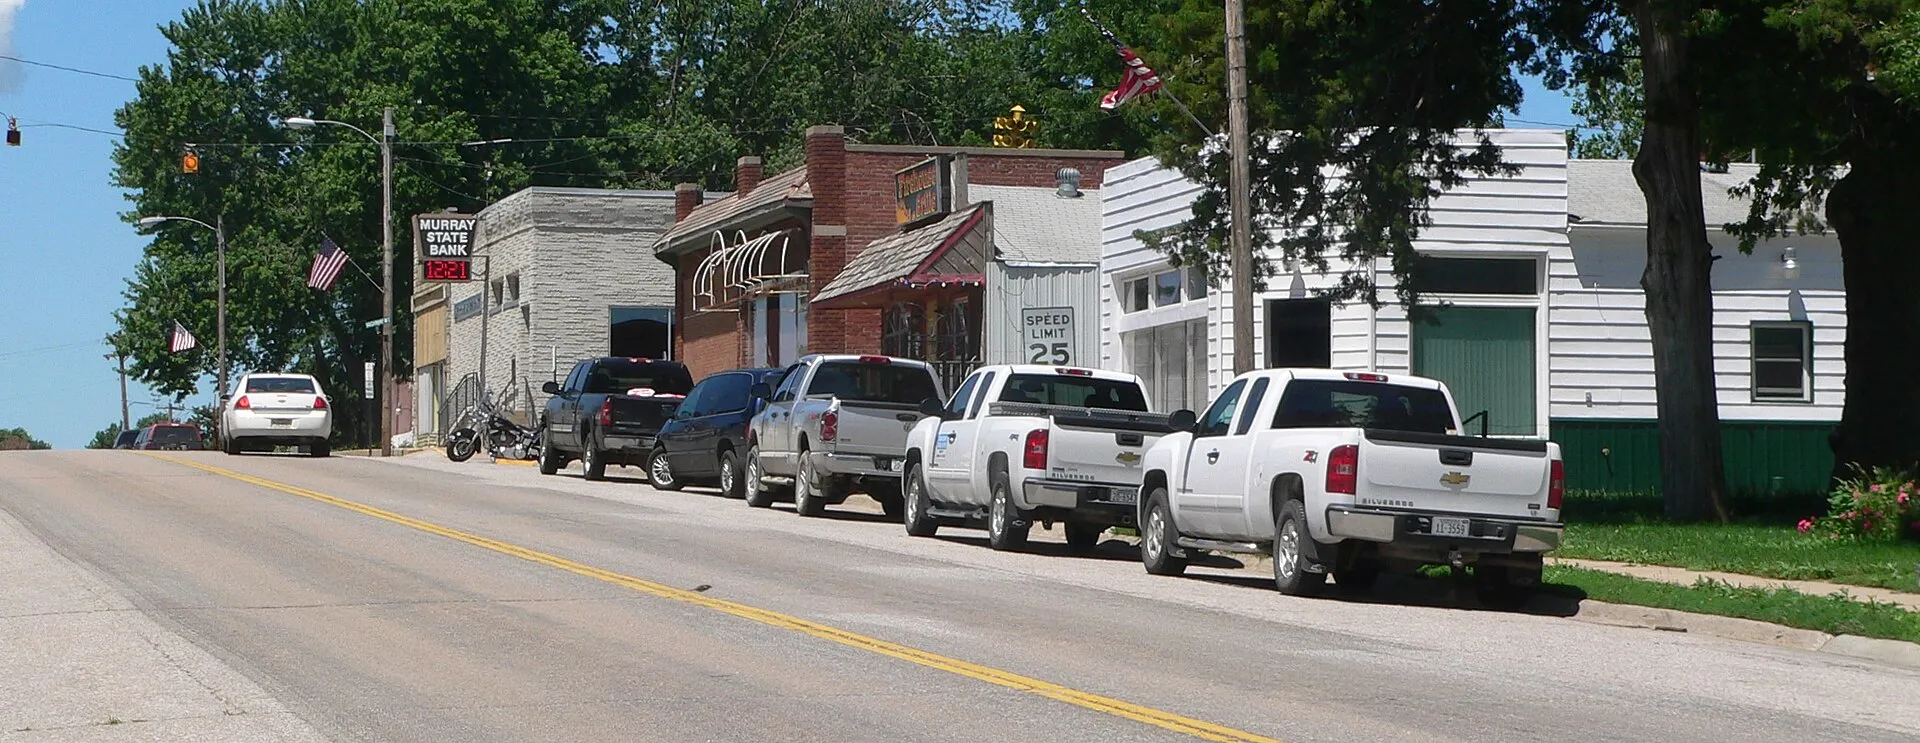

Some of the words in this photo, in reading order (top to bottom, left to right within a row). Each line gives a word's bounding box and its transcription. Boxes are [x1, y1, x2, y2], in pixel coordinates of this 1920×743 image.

[420, 219, 476, 231] MURRAY
[426, 231, 468, 243] STATE
[429, 244, 468, 256] BANK
[427, 261, 467, 279] 12:21
[1026, 314, 1070, 326] SPEED
[1031, 328, 1066, 339] LIMIT
[1029, 342, 1070, 366] 25
